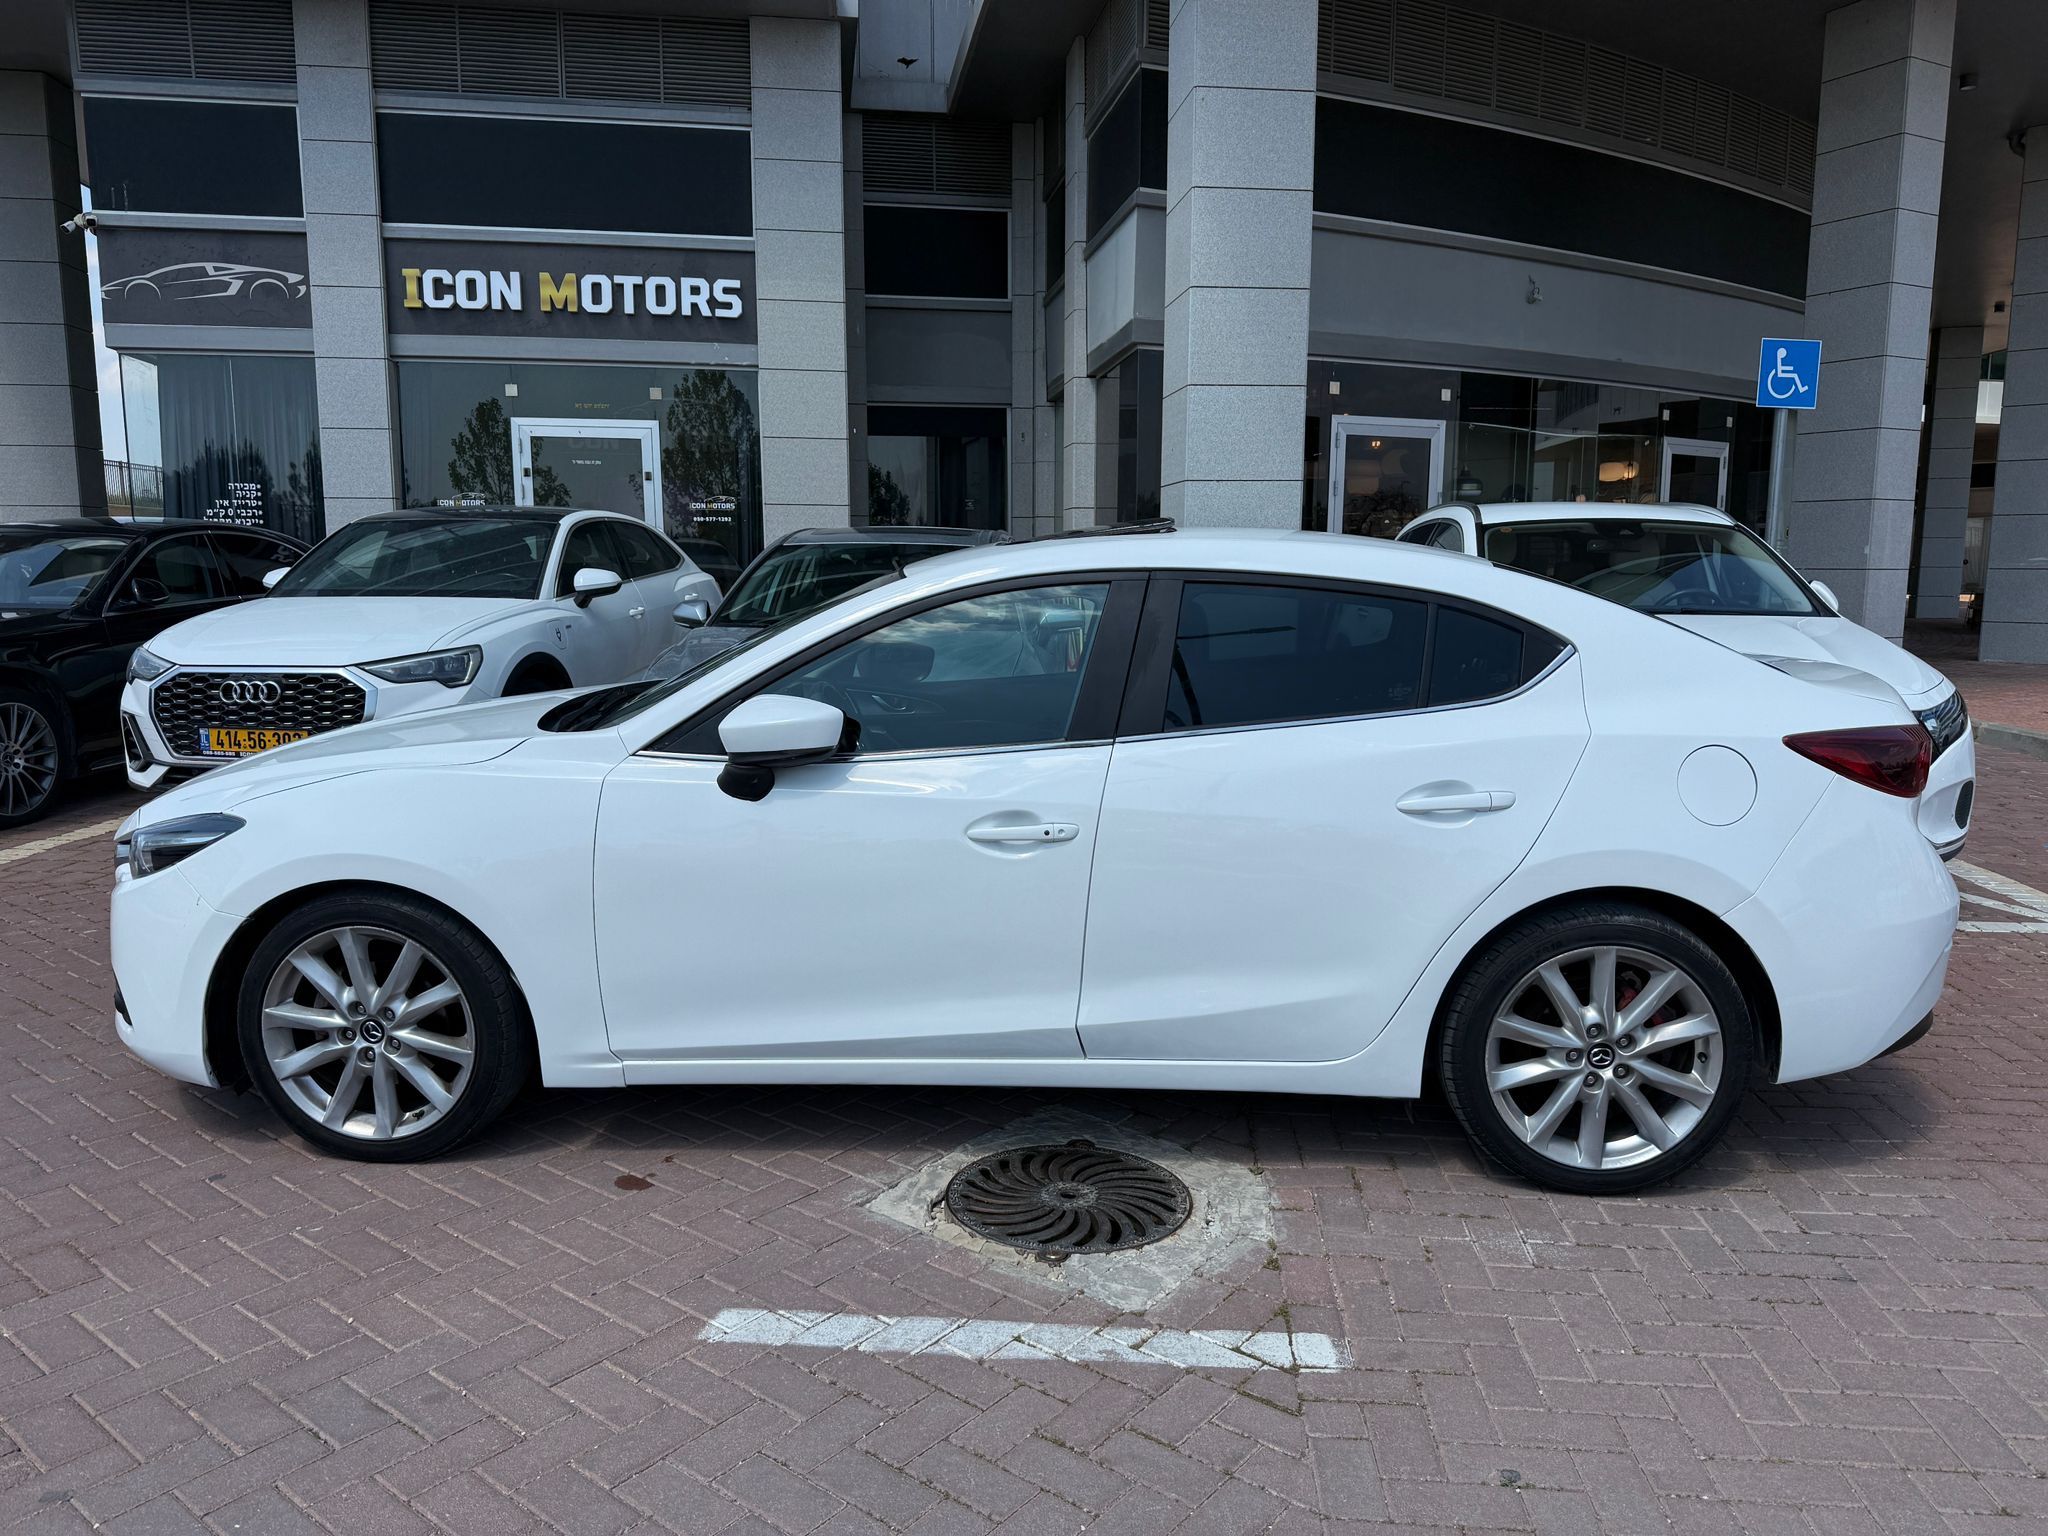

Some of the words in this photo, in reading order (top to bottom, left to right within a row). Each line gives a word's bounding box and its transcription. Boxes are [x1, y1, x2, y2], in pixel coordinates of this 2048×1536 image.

[401, 268, 523, 311] ICON
[538, 271, 743, 319] MOTORS
[228, 482, 256, 490] מכירה
[236, 490, 257, 499] קניה
[215, 499, 229, 508] אין
[227, 508, 234, 516] 0
